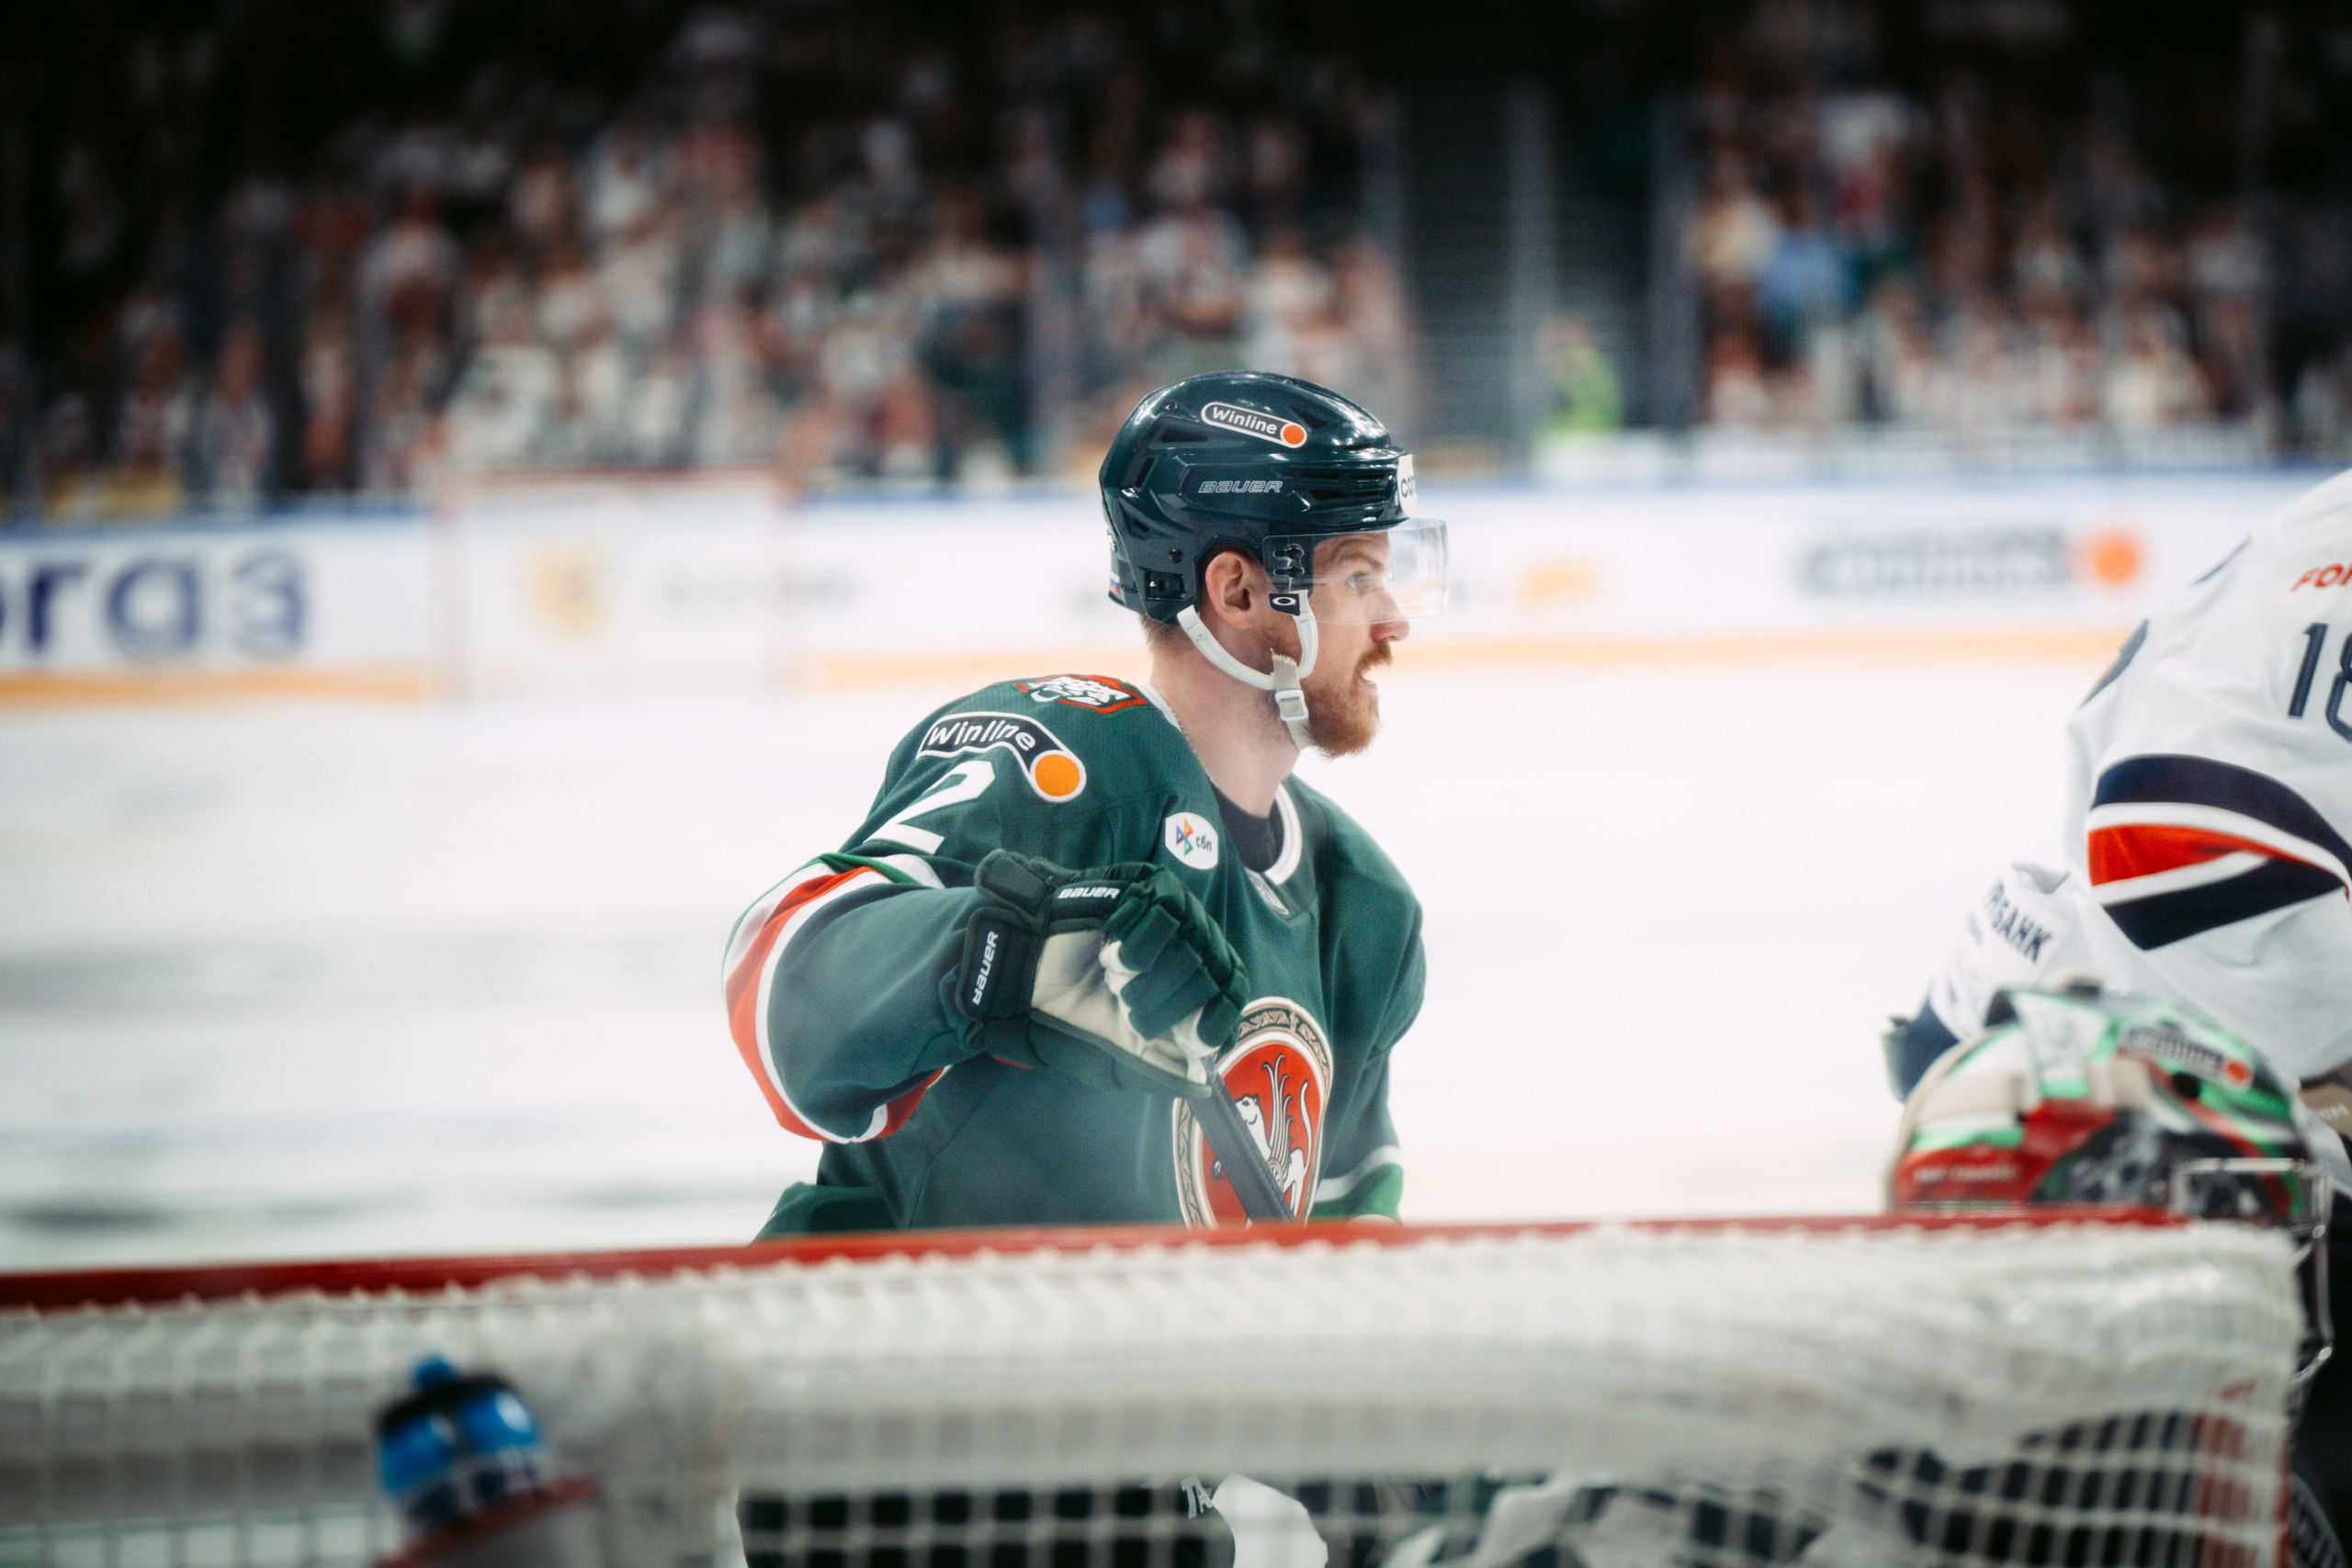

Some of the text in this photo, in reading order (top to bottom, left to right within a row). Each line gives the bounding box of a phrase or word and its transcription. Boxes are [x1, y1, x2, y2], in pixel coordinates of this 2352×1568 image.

[1213, 406, 1278, 434] Winline
[1198, 480, 1283, 494] BAUER
[0, 555, 307, 656] газ
[927, 720, 1036, 751] Winline
[863, 761, 996, 855] 2
[1057, 886, 1120, 899] BAUER
